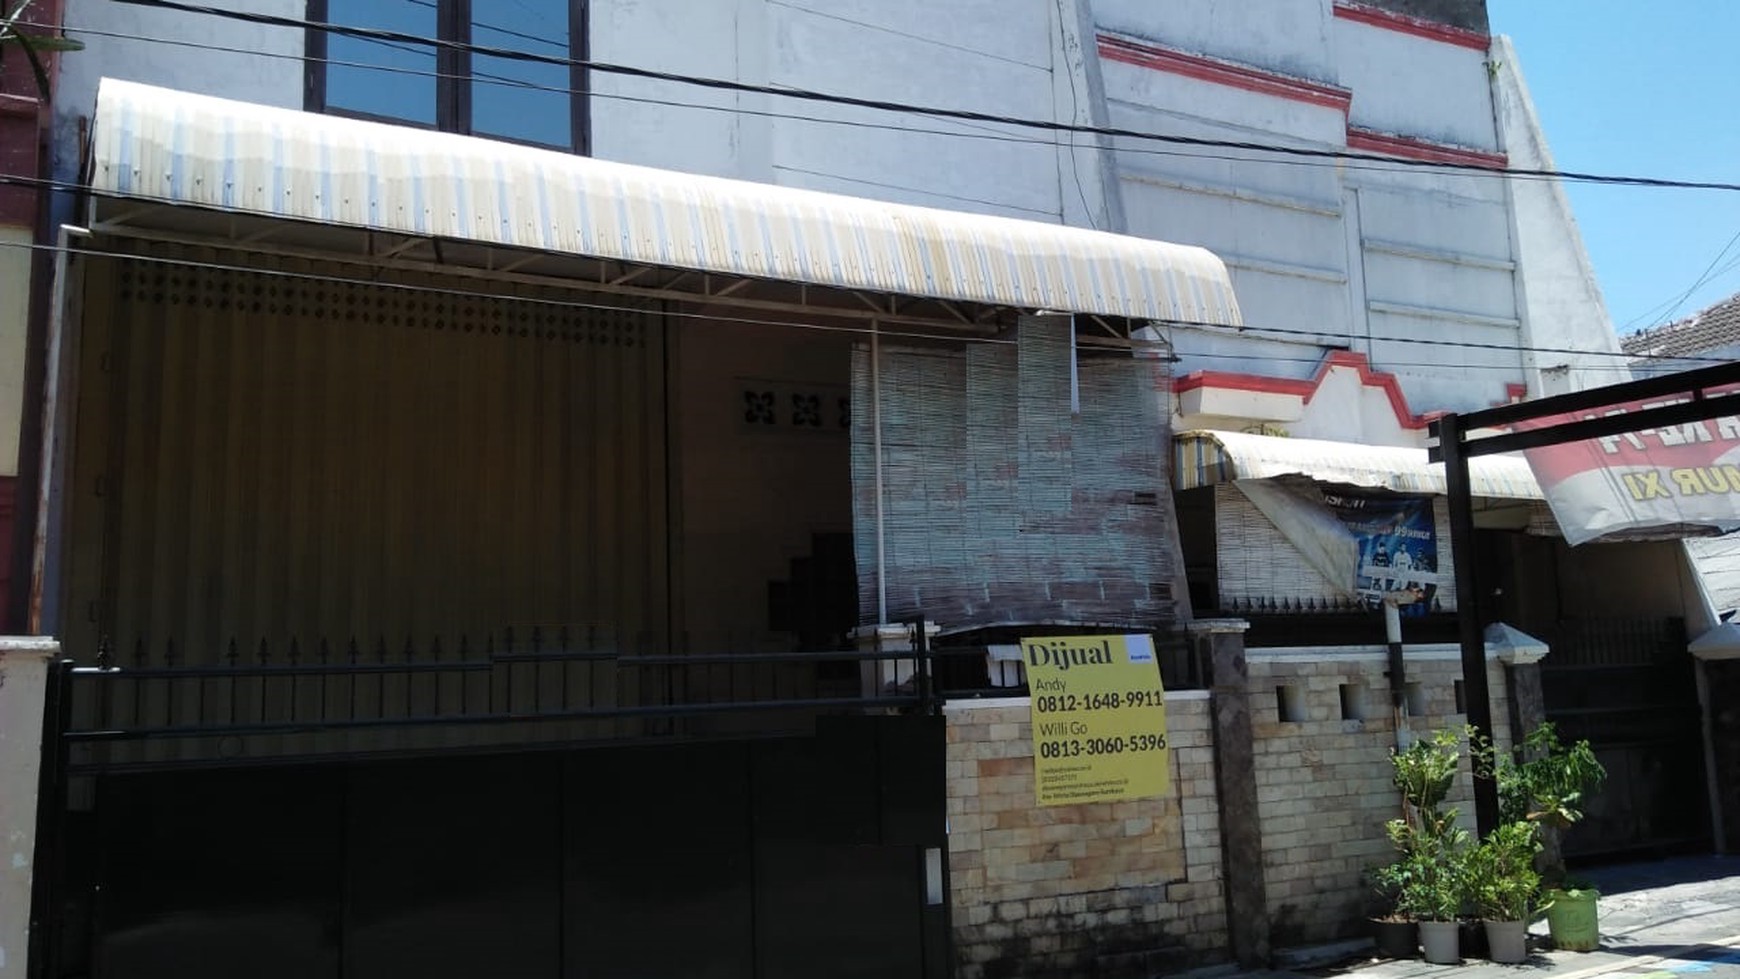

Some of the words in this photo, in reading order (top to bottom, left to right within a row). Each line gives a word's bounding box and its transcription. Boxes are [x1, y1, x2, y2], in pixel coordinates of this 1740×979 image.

[1028, 640, 1113, 670] Dijual
[1036, 678, 1066, 692] Andy
[1037, 691, 1163, 713] 0812-1648-9911
[1039, 722, 1068, 736] Willi
[1070, 721, 1088, 735] Go
[1040, 734, 1166, 758] 0813-3060-5396
